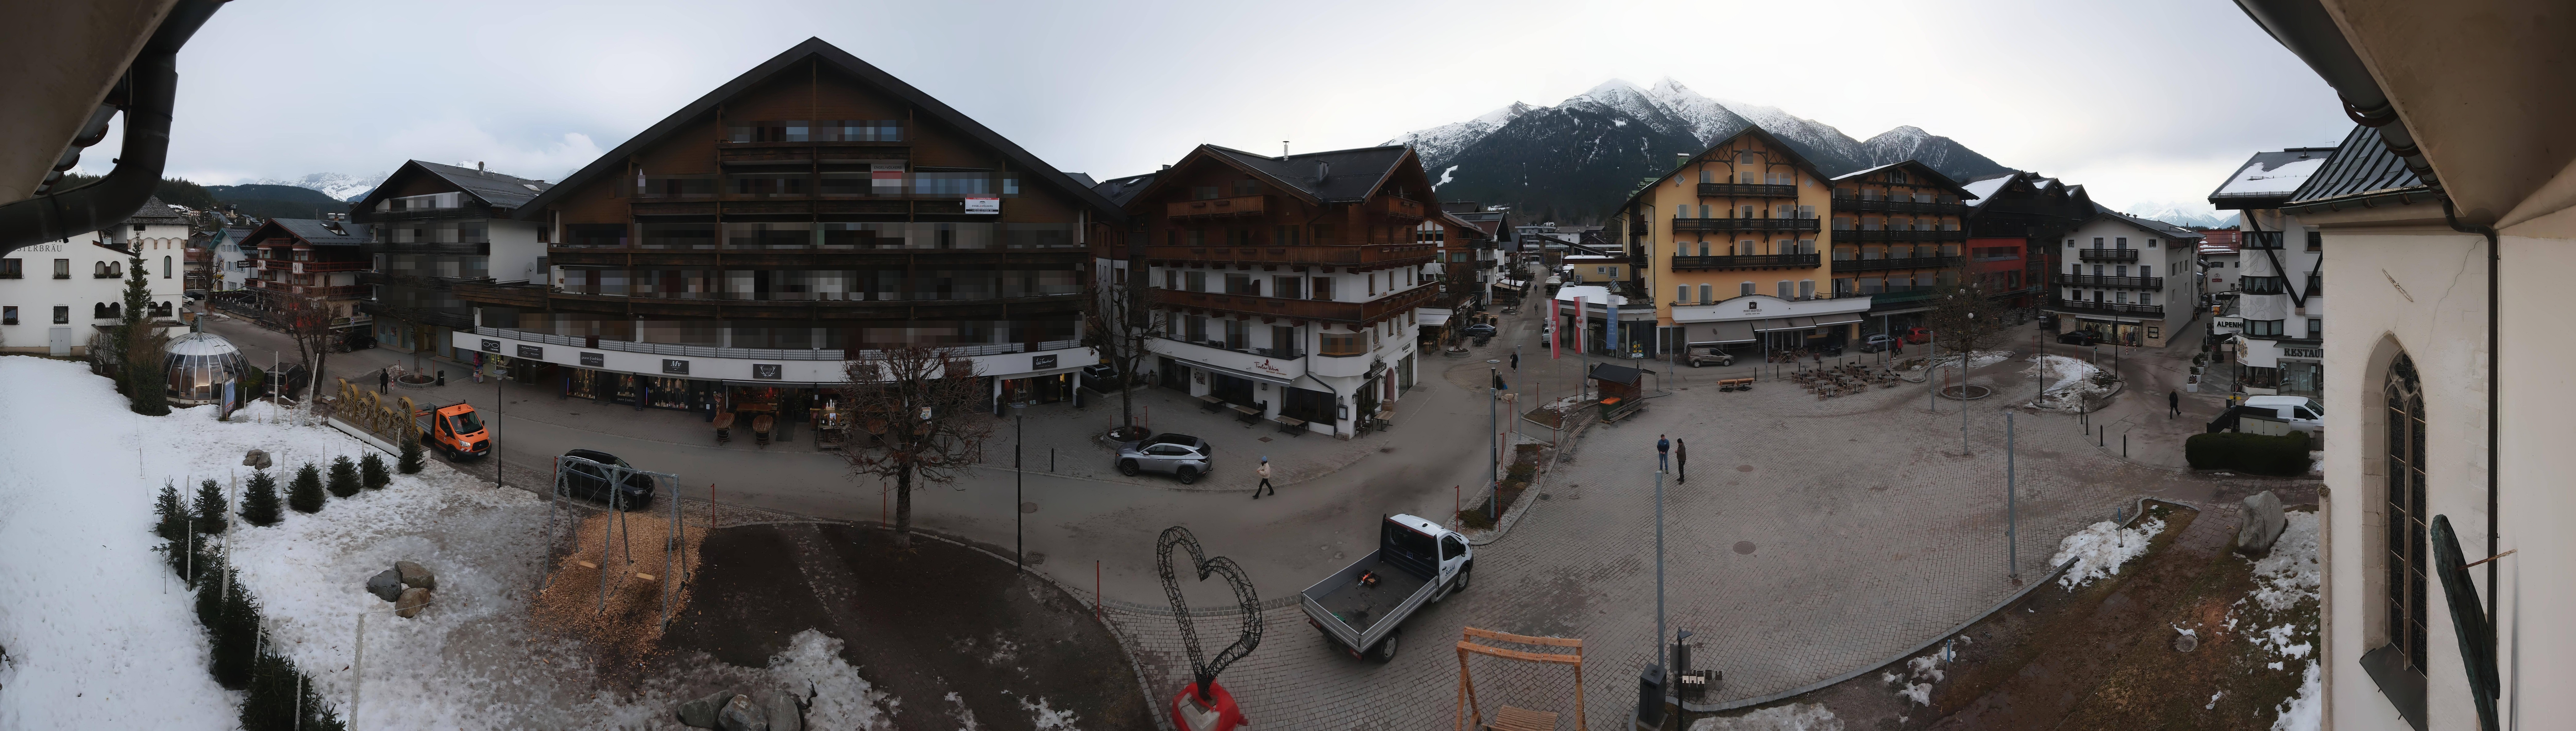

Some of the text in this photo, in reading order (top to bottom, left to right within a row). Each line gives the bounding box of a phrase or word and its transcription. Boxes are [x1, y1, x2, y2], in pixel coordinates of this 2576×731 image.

[1402, 343, 1411, 352] SAILER
[1372, 364, 1386, 377] RESTAURANT
[1445, 564, 1455, 576] Seefeld
[1394, 585, 1435, 622] TEAM INFRASTRUKTUR
